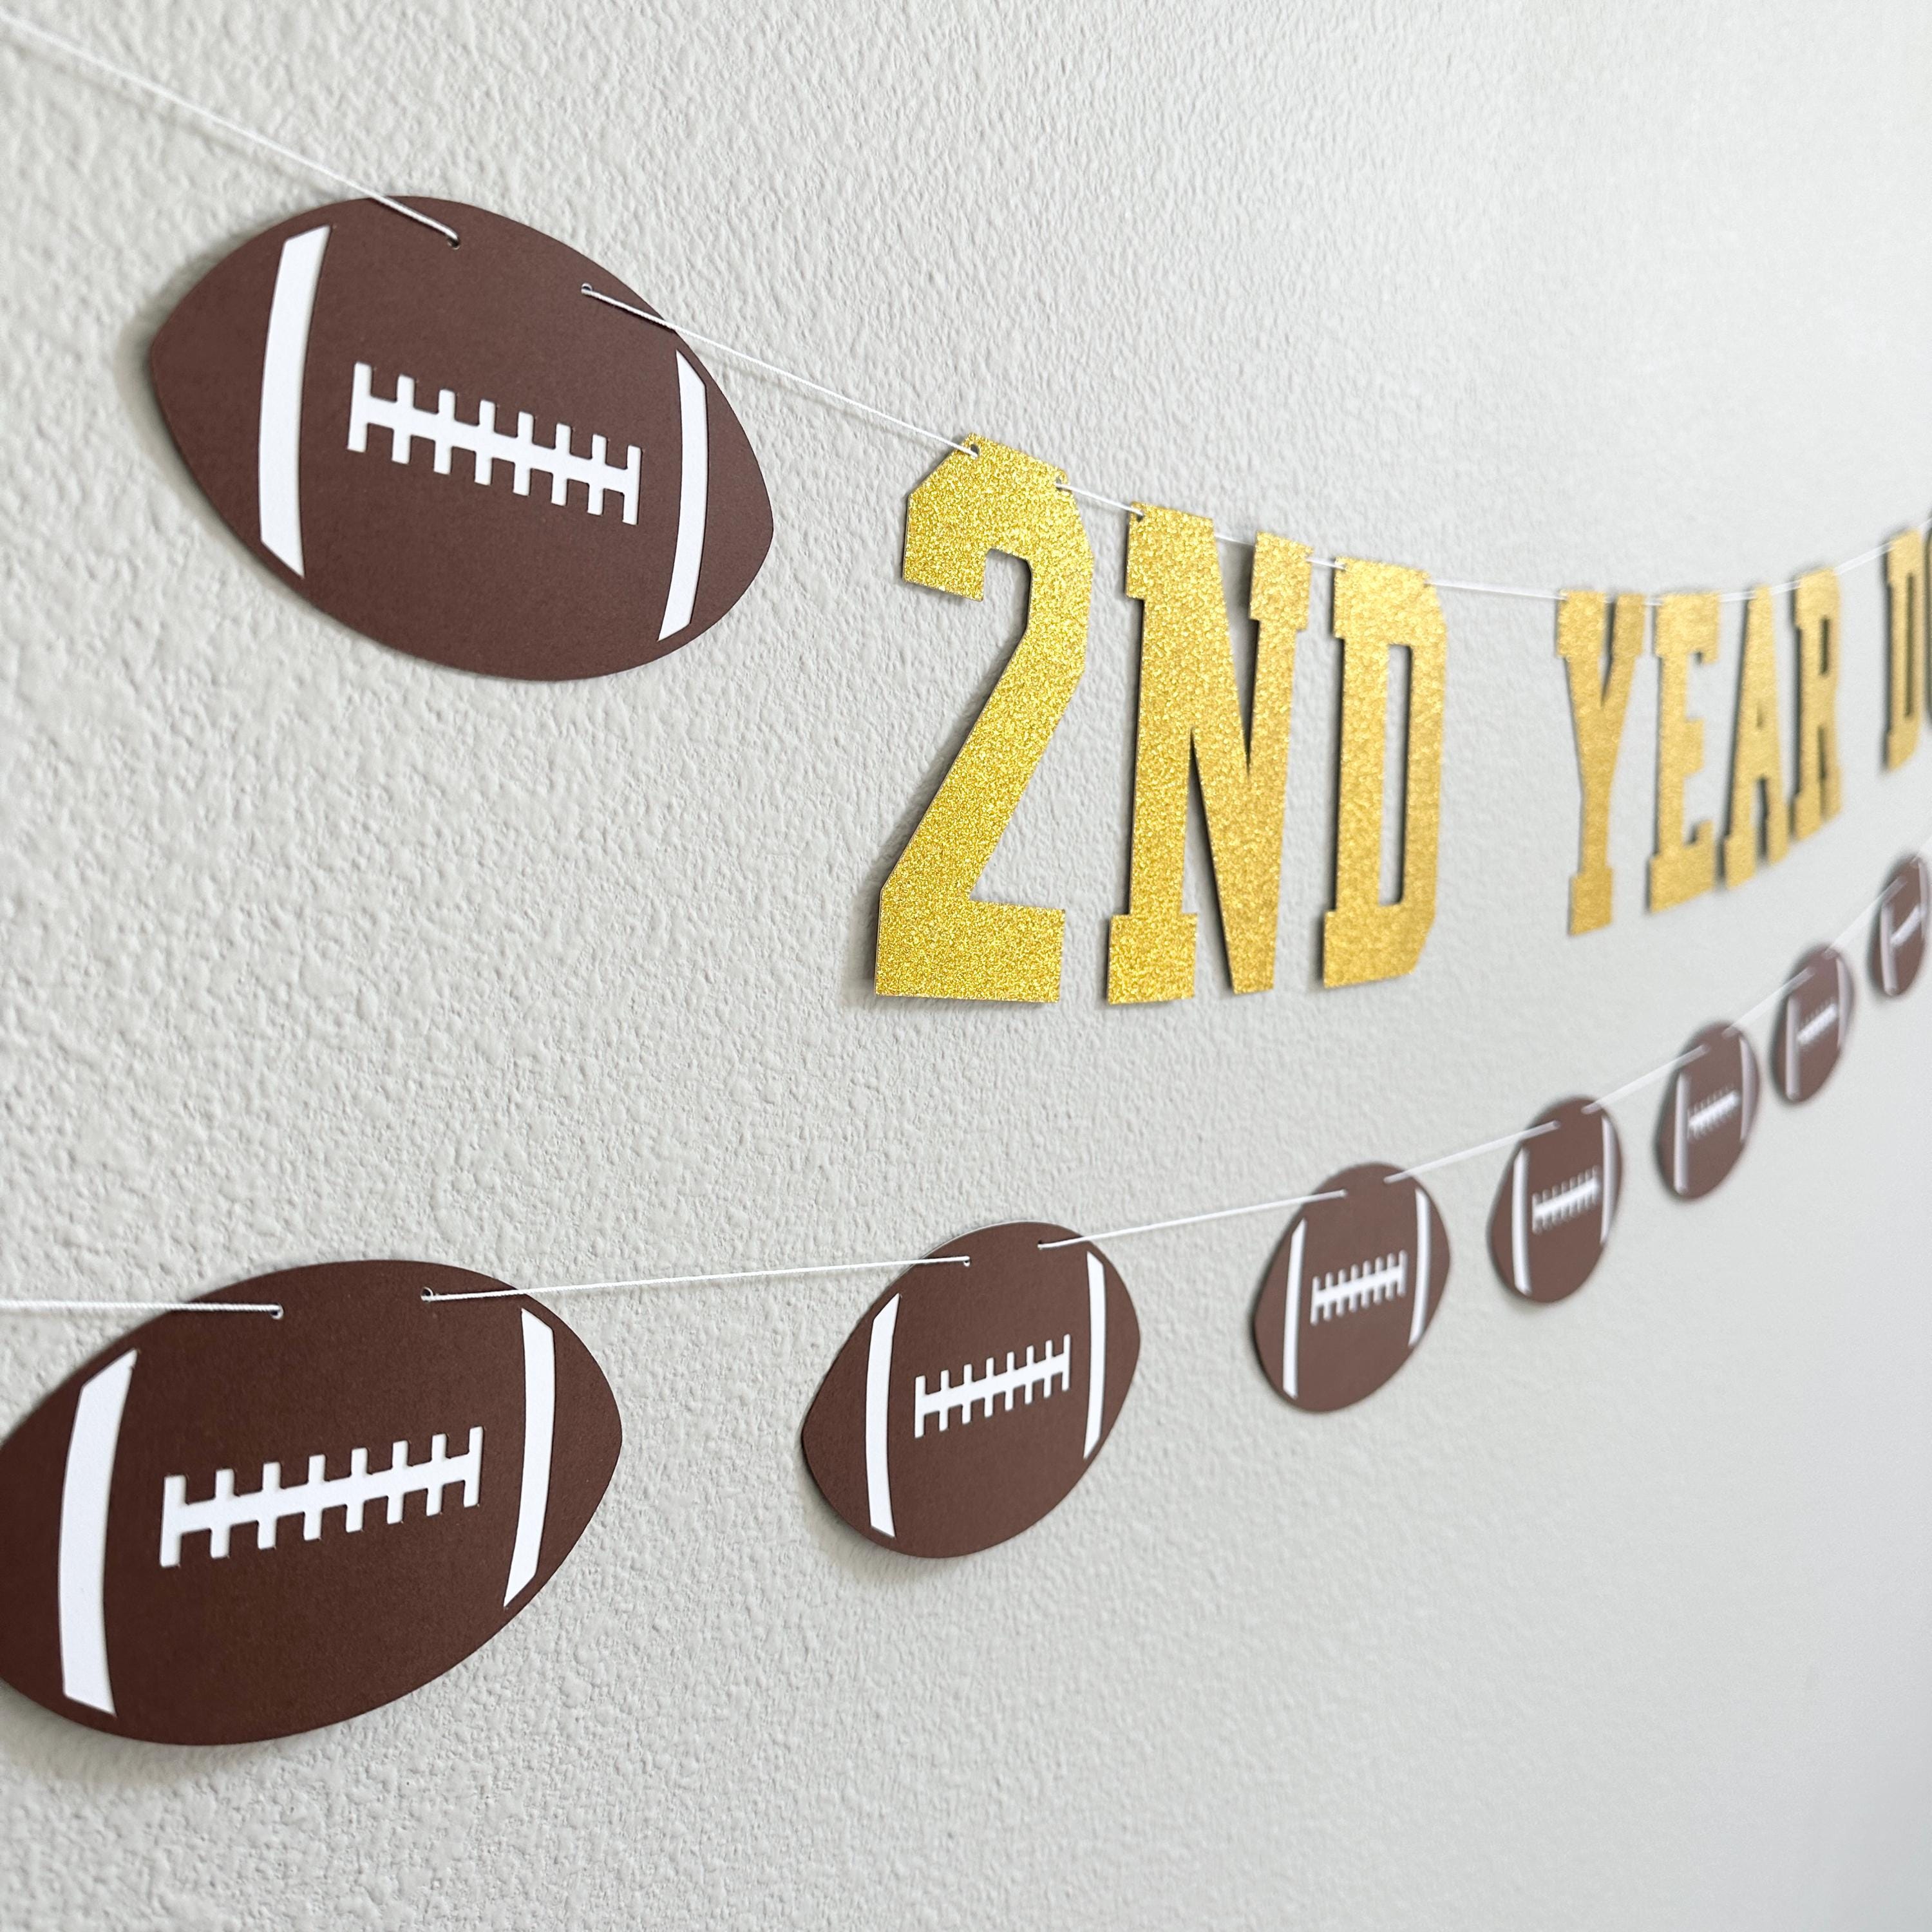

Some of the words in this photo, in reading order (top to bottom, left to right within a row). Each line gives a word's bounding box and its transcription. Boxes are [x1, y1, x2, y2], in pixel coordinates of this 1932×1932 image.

[874, 432, 1448, 1005] 2ND
[1556, 567, 1842, 936] YEAR
[1884, 528, 1932, 771] D
